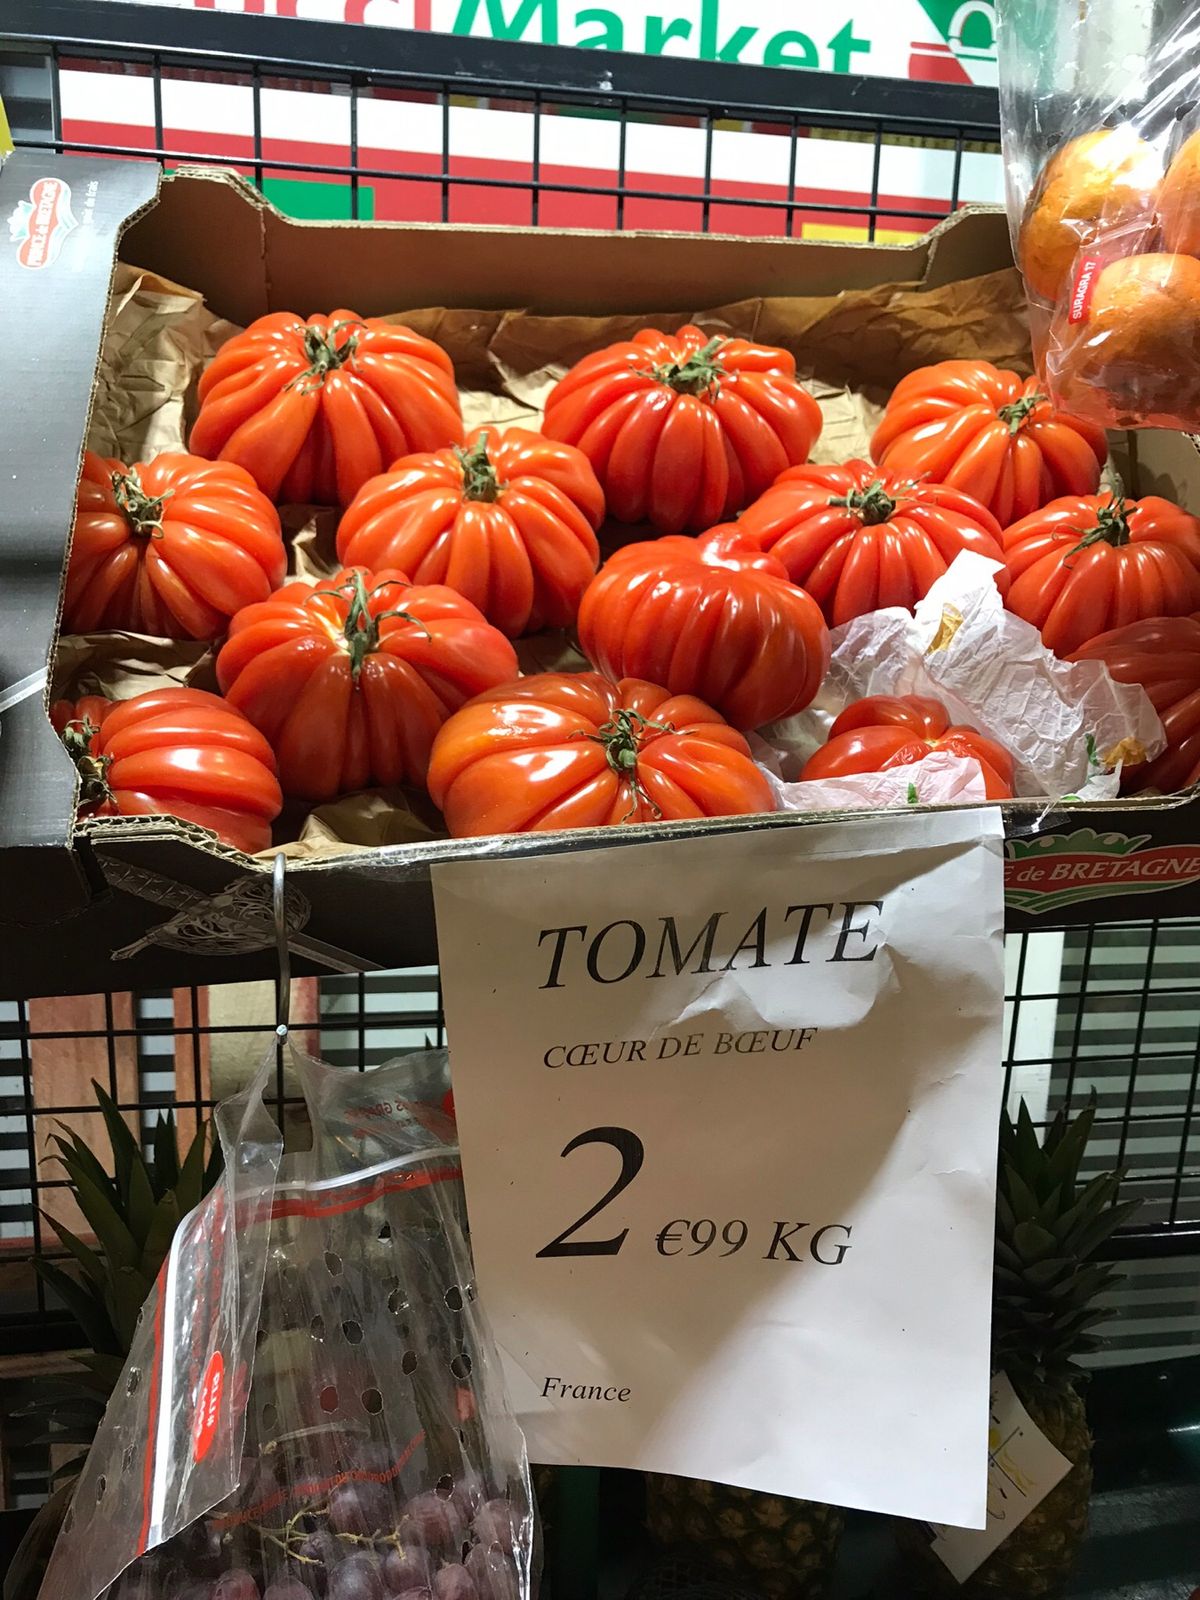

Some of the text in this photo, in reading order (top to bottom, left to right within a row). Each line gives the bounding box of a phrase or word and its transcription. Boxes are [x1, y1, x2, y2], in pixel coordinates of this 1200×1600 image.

[451, 0, 871, 73] Market
[1072, 261, 1096, 320] SURAGRA 17
[1017, 865, 1045, 882] de
[1048, 857, 1200, 881] BRETAGNE
[538, 900, 884, 990] TOMATE
[543, 1027, 818, 1069] CŒUR DE BŒUF
[535, 1126, 854, 1266] 2 €99 KG
[540, 1377, 632, 1403] France
